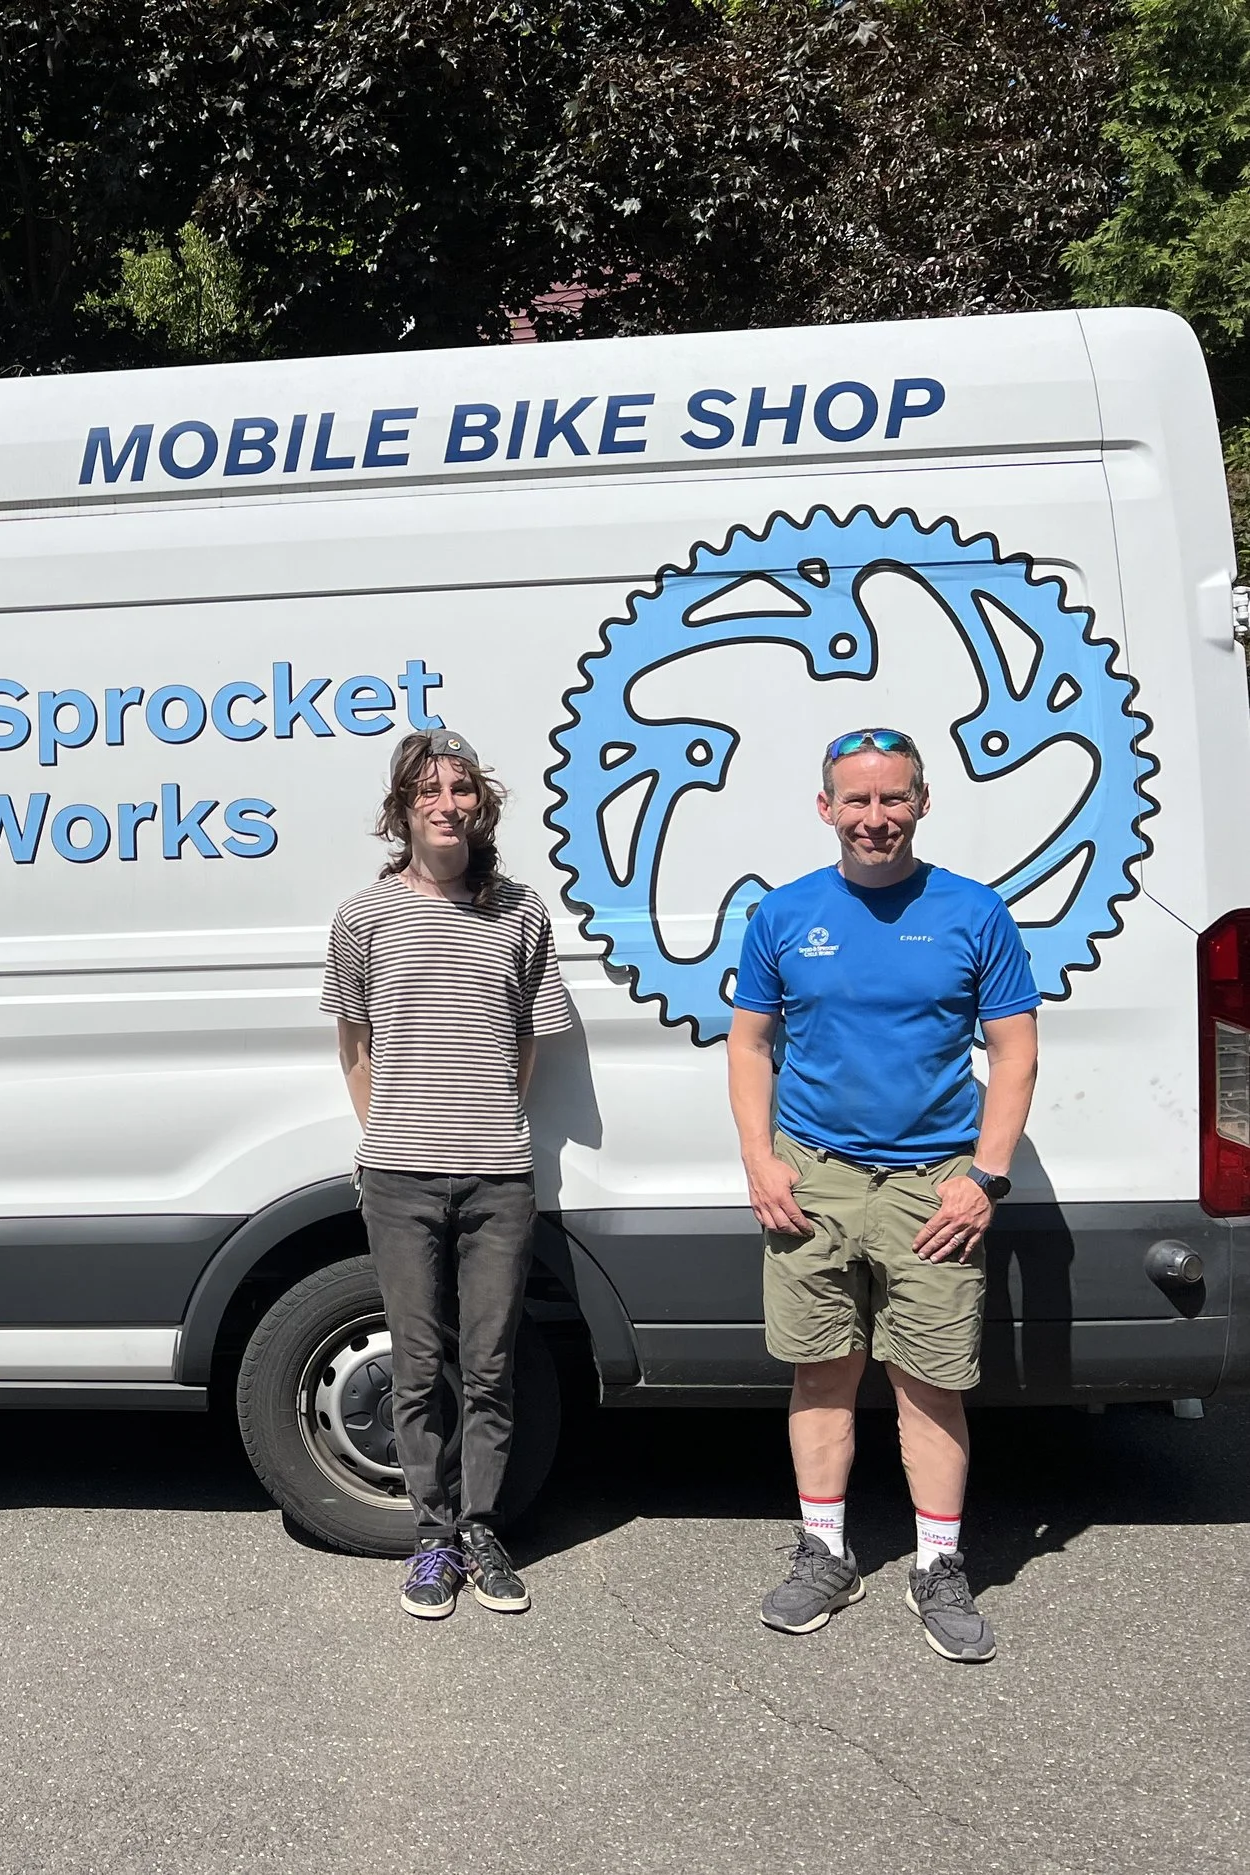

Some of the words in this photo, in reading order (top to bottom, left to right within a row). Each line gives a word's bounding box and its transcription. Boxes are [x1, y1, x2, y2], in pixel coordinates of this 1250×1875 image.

[78, 407, 419, 485] MOBILE
[444, 393, 656, 463] BIKE
[679, 377, 947, 451] SHOP
